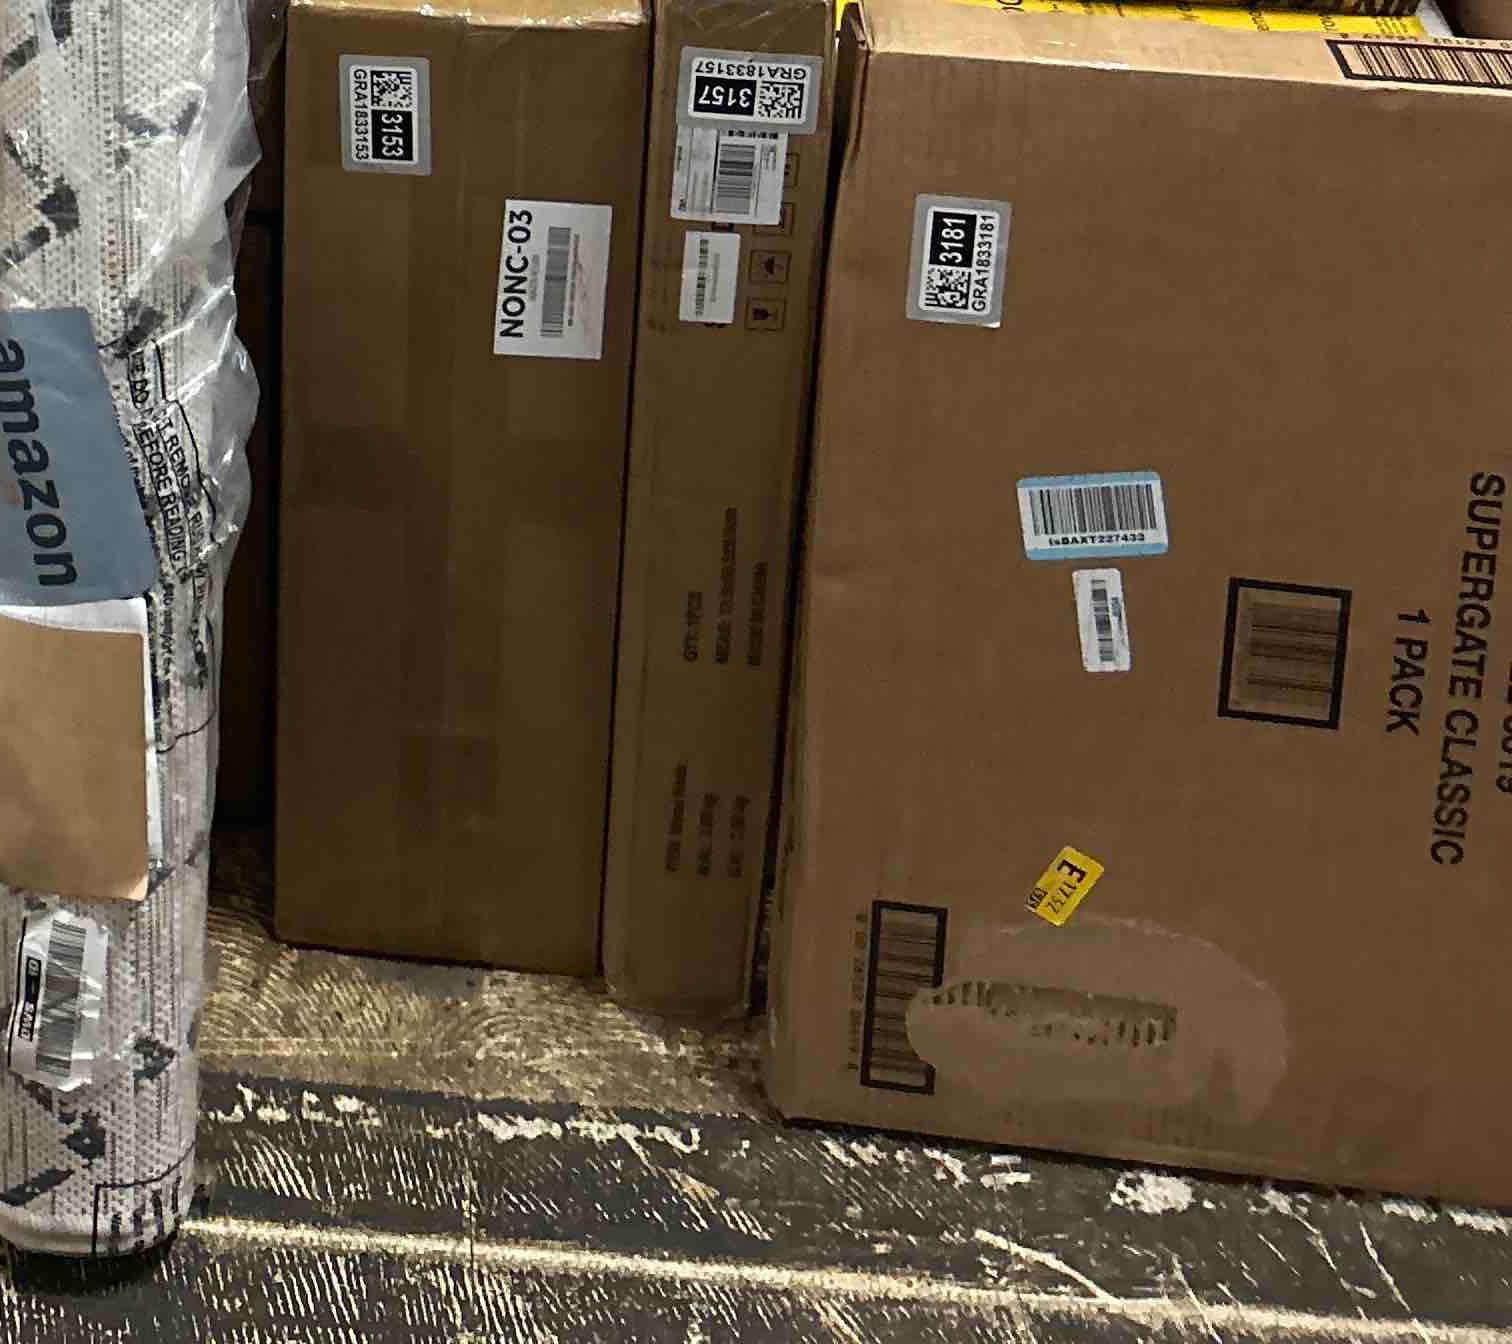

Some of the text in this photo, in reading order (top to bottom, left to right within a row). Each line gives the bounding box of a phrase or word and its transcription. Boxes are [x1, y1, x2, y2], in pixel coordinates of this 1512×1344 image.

[353, 68, 370, 161] GRA1833153
[694, 59, 807, 81] GRA1833157
[697, 84, 753, 107] 3157
[380, 113, 405, 159] 3153
[498, 209, 533, 340] NONC-03
[938, 217, 966, 263] 3181
[972, 213, 996, 312] GRA1833181
[1384, 608, 1429, 735] 1 PACK
[1429, 470, 1506, 866] SUPERGATE CLASSIC
